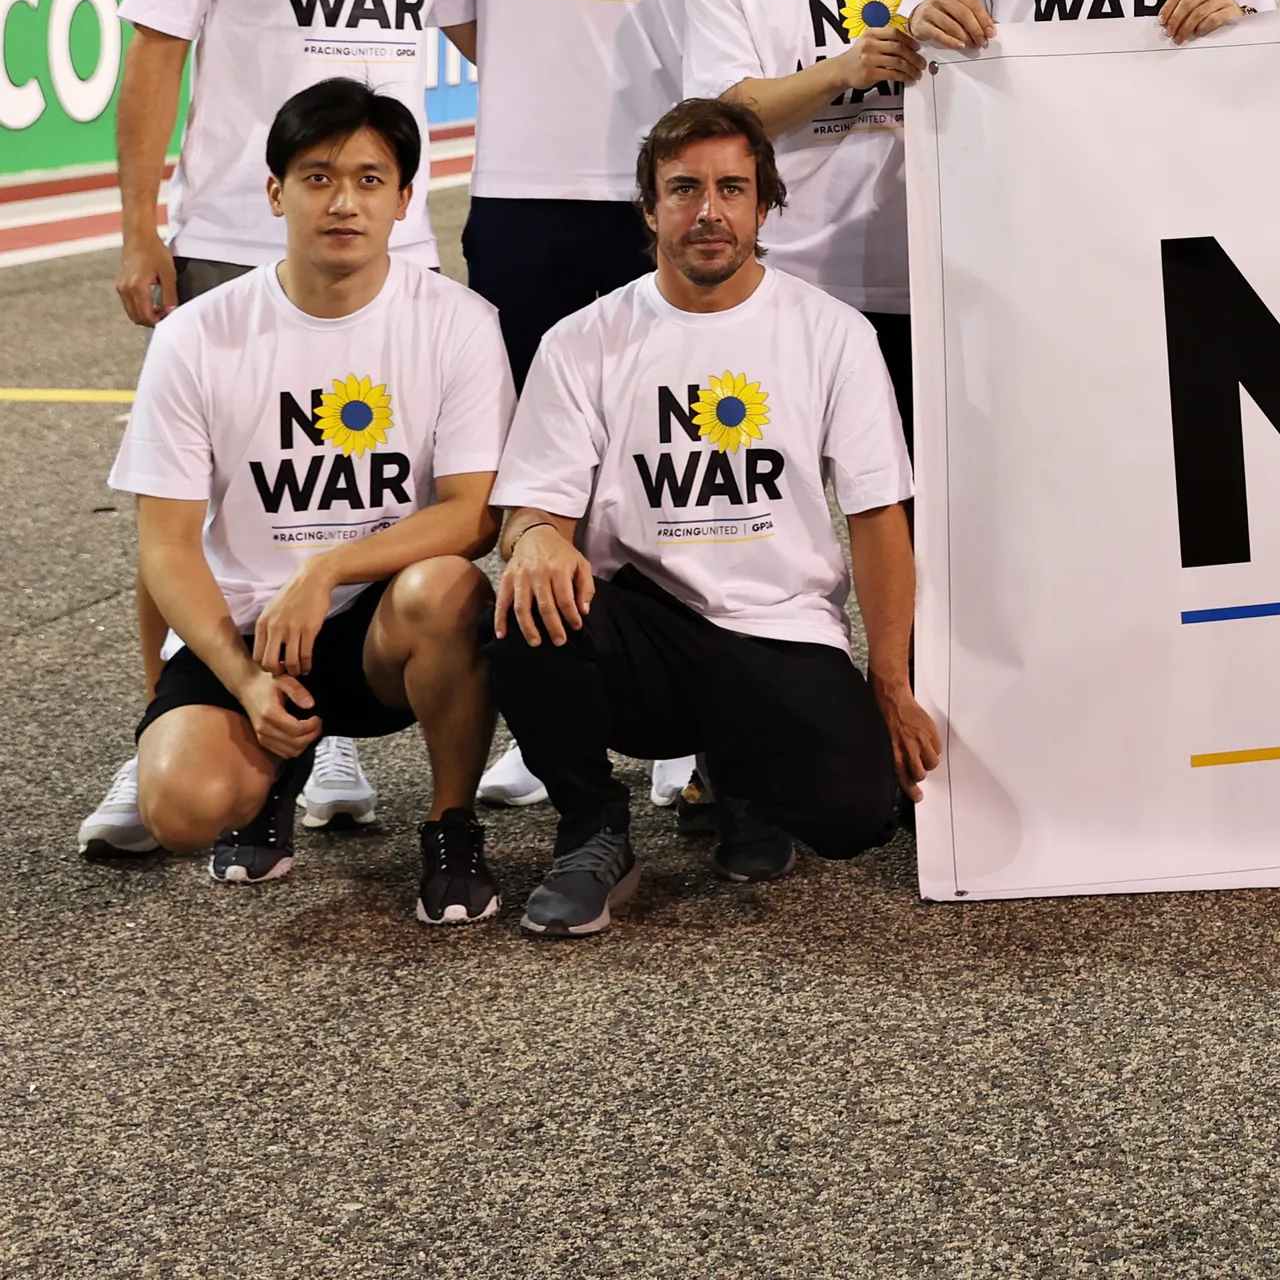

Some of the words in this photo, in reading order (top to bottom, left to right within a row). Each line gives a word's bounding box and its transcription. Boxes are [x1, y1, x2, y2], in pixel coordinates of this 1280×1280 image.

[304, 46, 387, 57] #RACINGUNITED
[249, 452, 412, 513] WAR
[632, 448, 785, 508] WAR
[657, 525, 738, 538] #RACINGUNITED
[751, 521, 775, 532] GPDA
